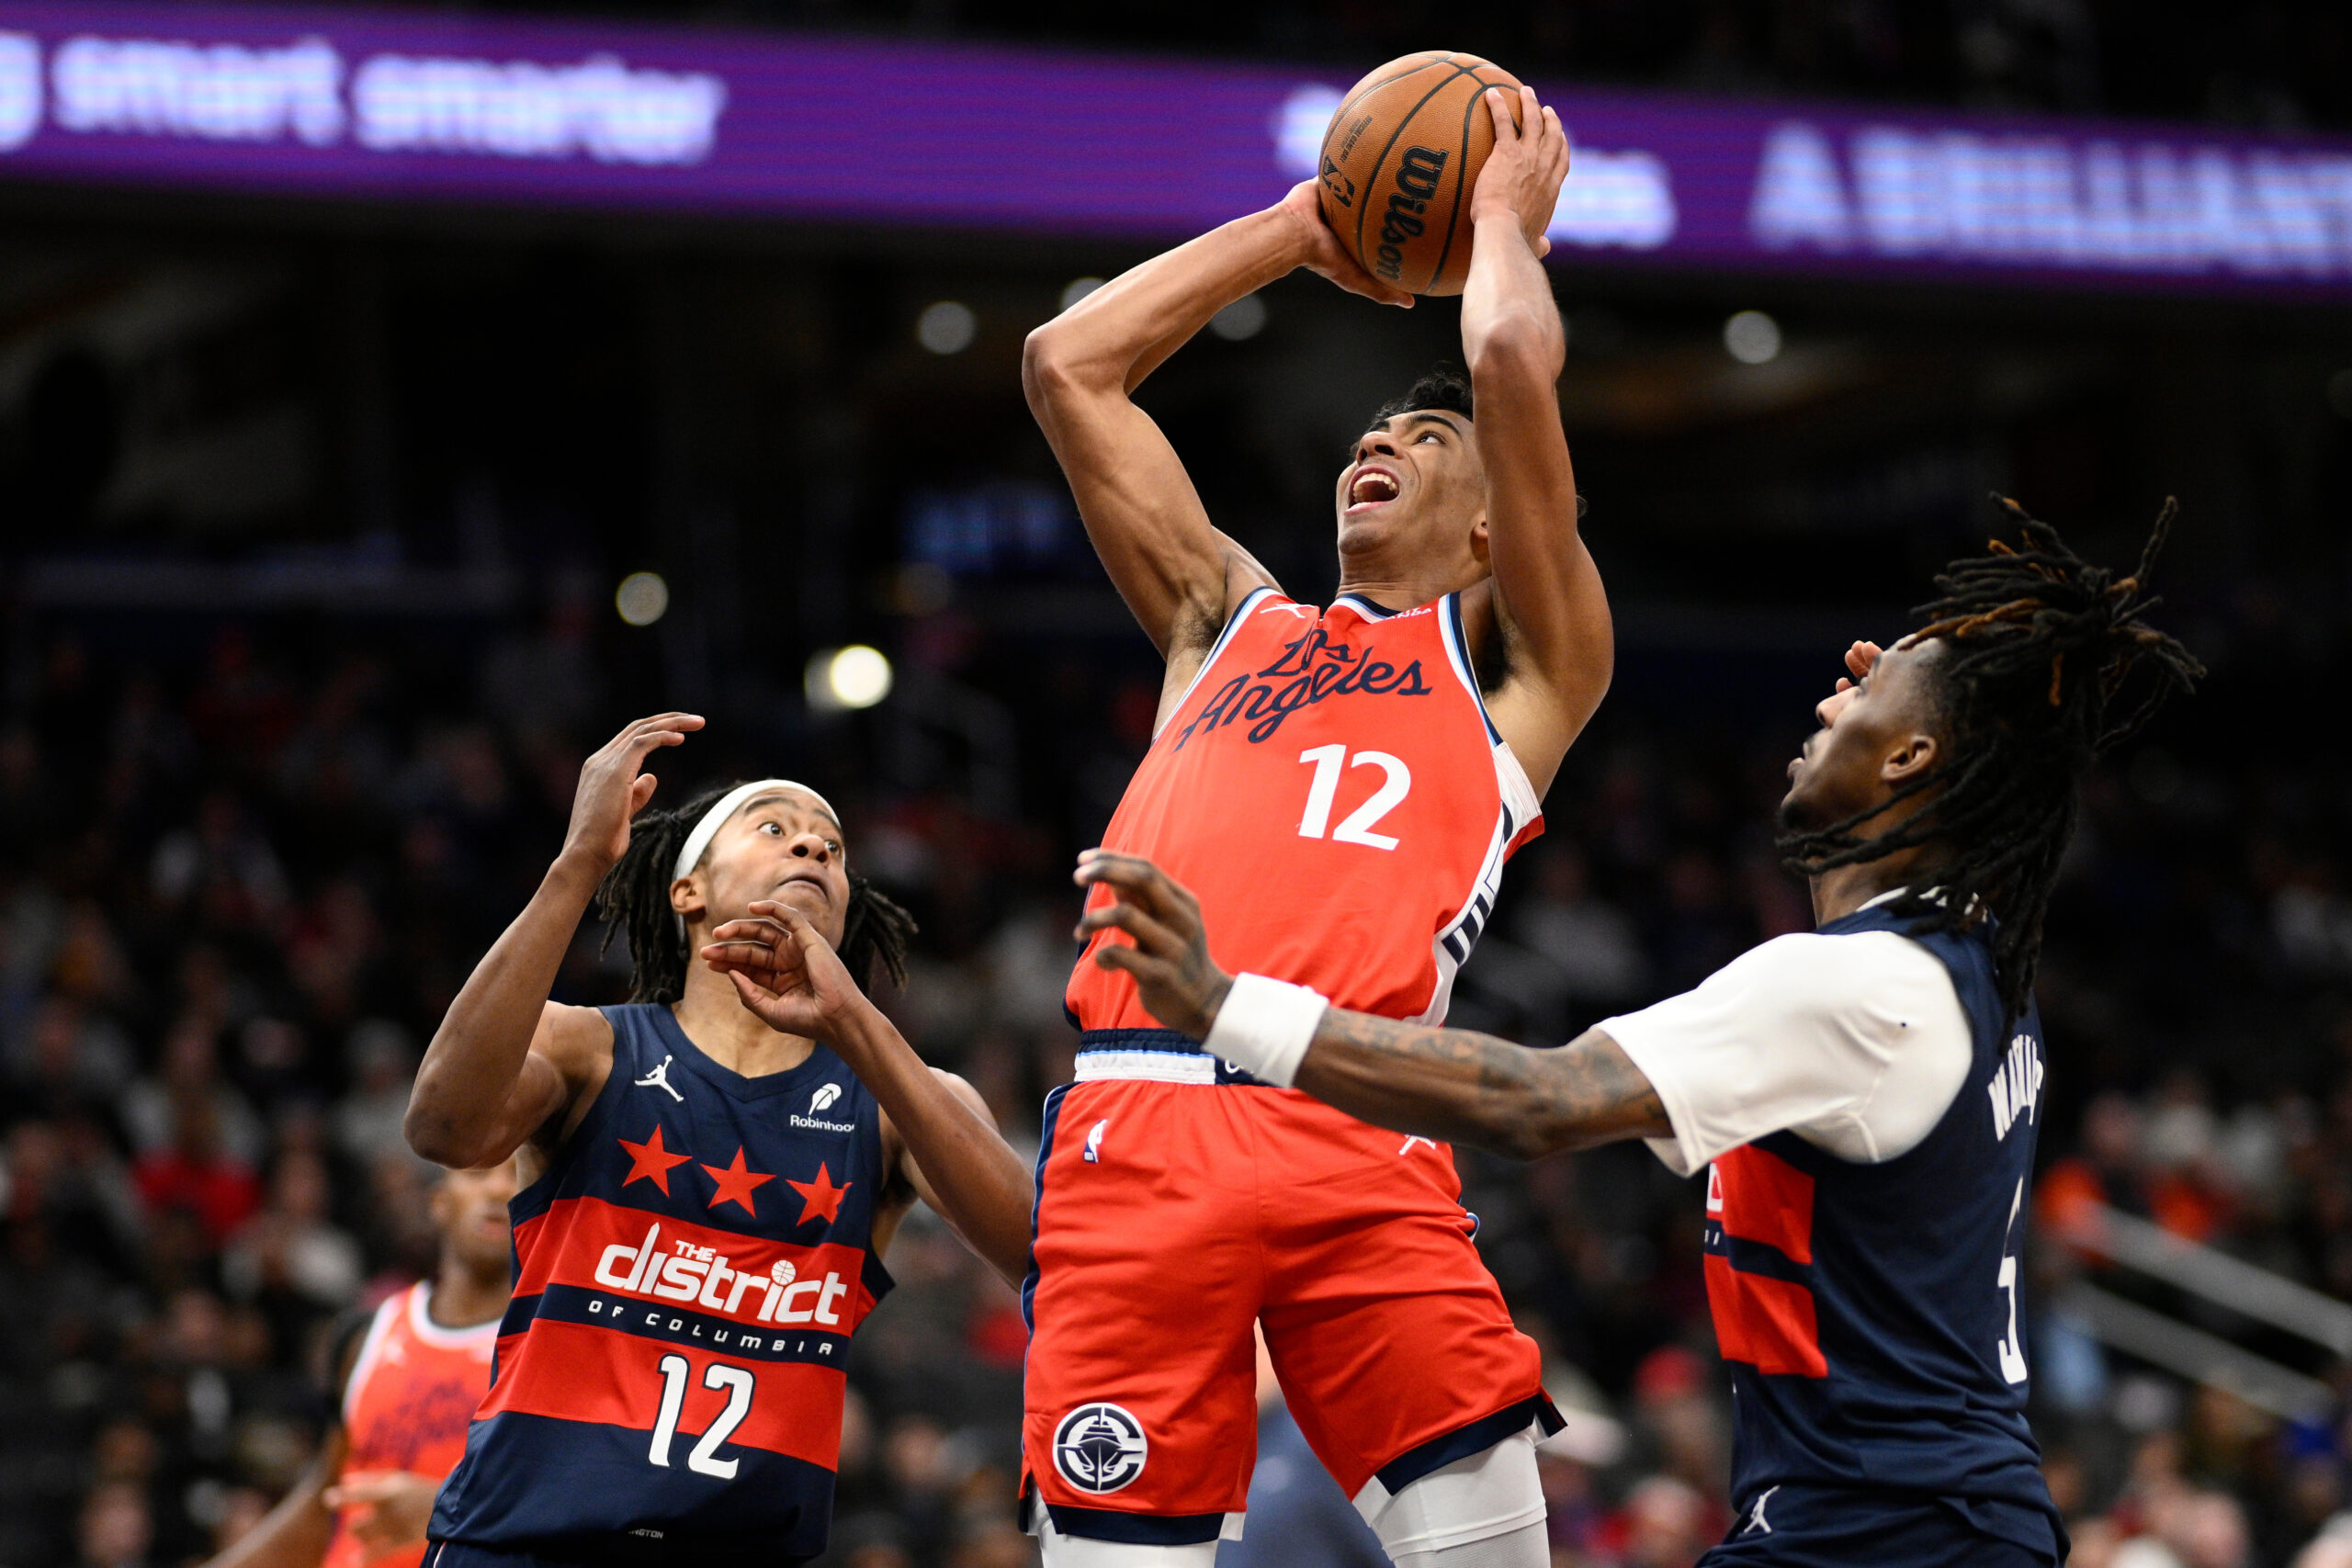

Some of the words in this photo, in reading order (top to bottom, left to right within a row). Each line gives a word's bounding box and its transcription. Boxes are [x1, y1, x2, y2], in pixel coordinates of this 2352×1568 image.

[1374, 145, 1450, 281] Wilson
[1173, 646, 1433, 753] Angeles
[1257, 622, 1358, 678] Los
[1297, 743, 1412, 852] 12
[594, 1221, 848, 1325] district
[675, 1239, 717, 1263] THE
[588, 1299, 625, 1318] OF
[645, 1312, 833, 1356] COLUMBIA
[648, 1354, 755, 1481] 12
